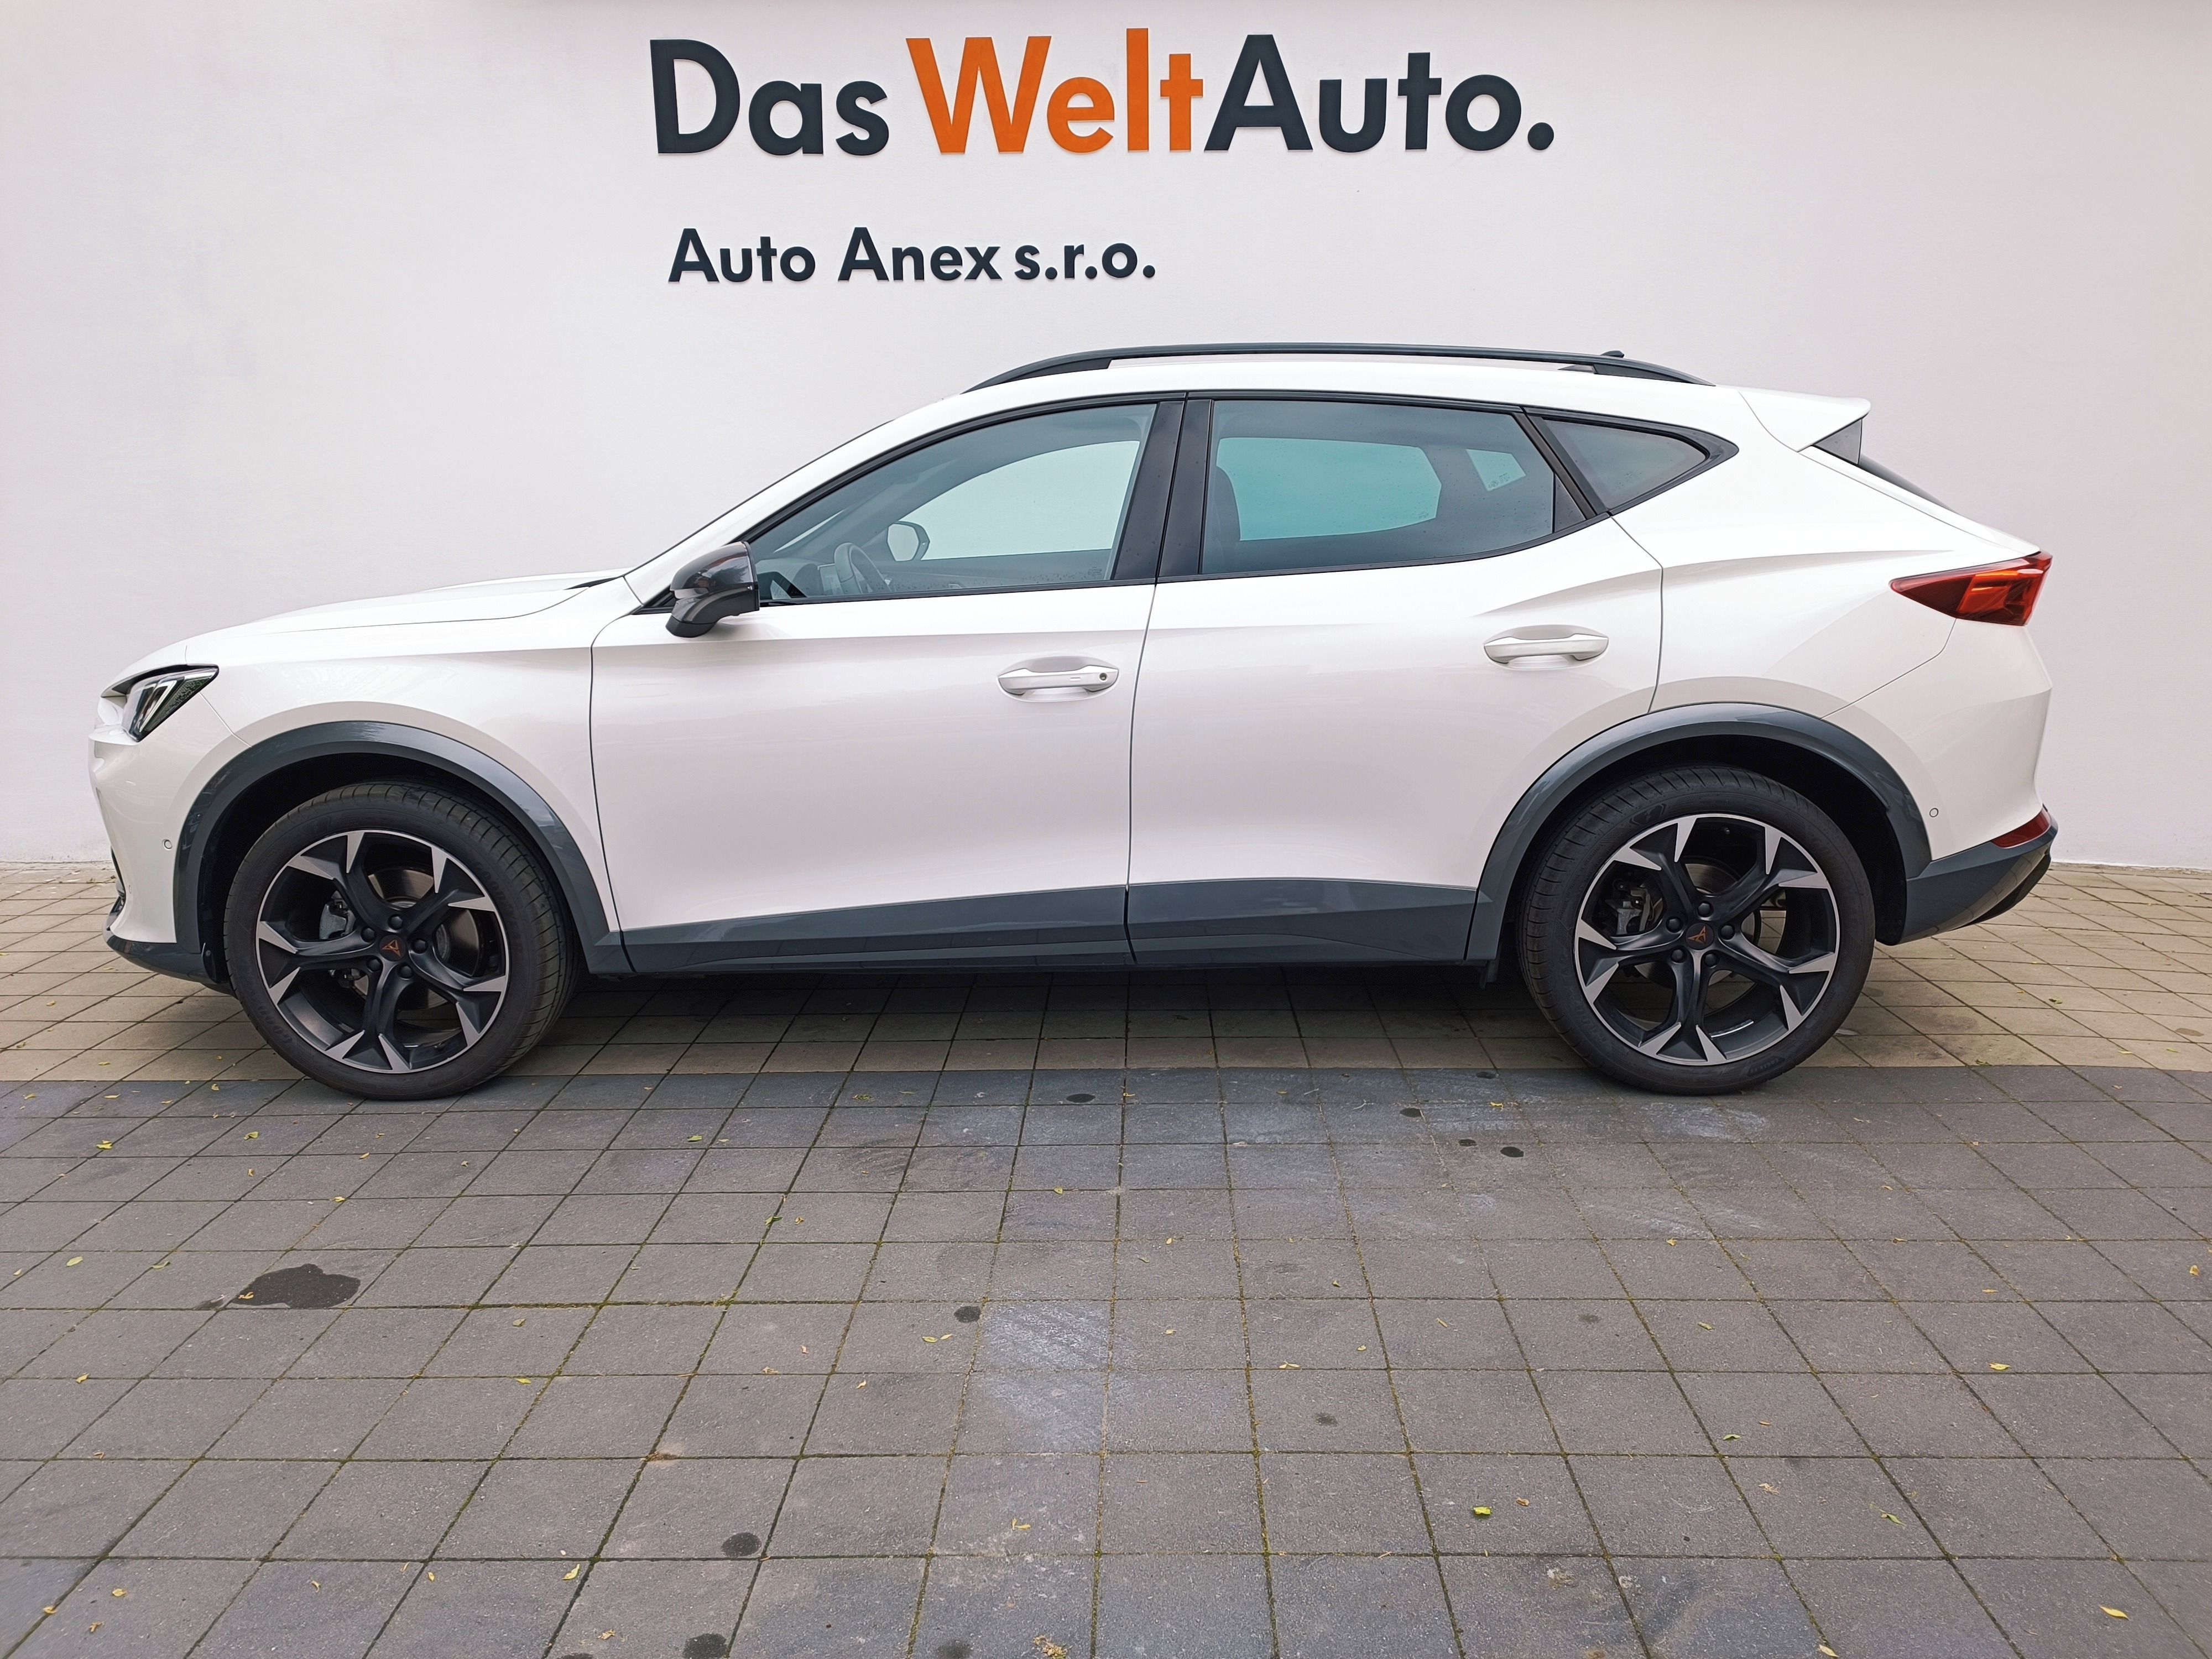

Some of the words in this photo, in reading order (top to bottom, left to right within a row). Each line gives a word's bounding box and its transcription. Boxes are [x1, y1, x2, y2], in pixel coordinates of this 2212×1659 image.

[650, 39, 889, 156] Das
[906, 28, 1554, 155] WeltAuto.
[669, 228, 816, 283] Auto
[838, 227, 1003, 281] Anex
[1015, 243, 1156, 280] s.r.o.
